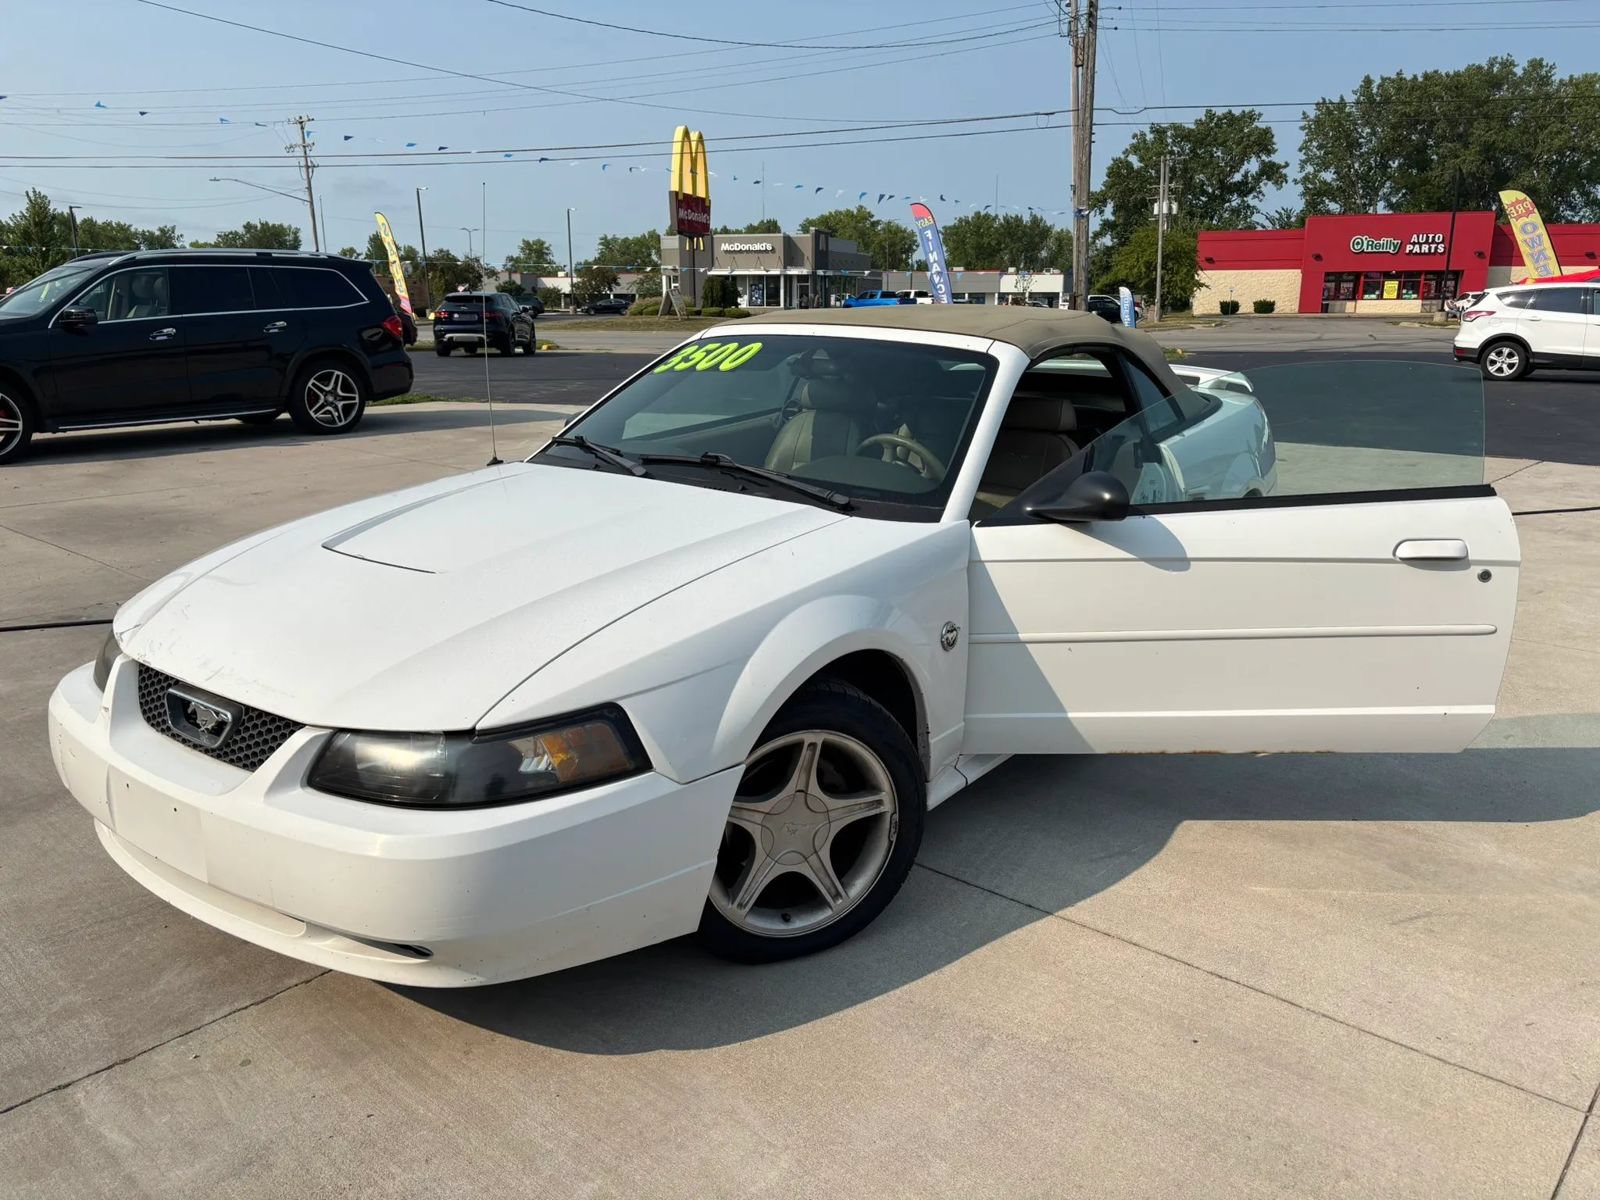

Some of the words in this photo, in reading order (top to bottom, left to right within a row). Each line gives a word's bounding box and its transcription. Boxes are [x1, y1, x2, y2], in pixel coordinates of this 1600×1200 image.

[1410, 233, 1443, 243] AUTO
[721, 242, 772, 251] McDonald's
[1350, 235, 1400, 253] O'Reilly
[1405, 243, 1445, 254] PARTS
